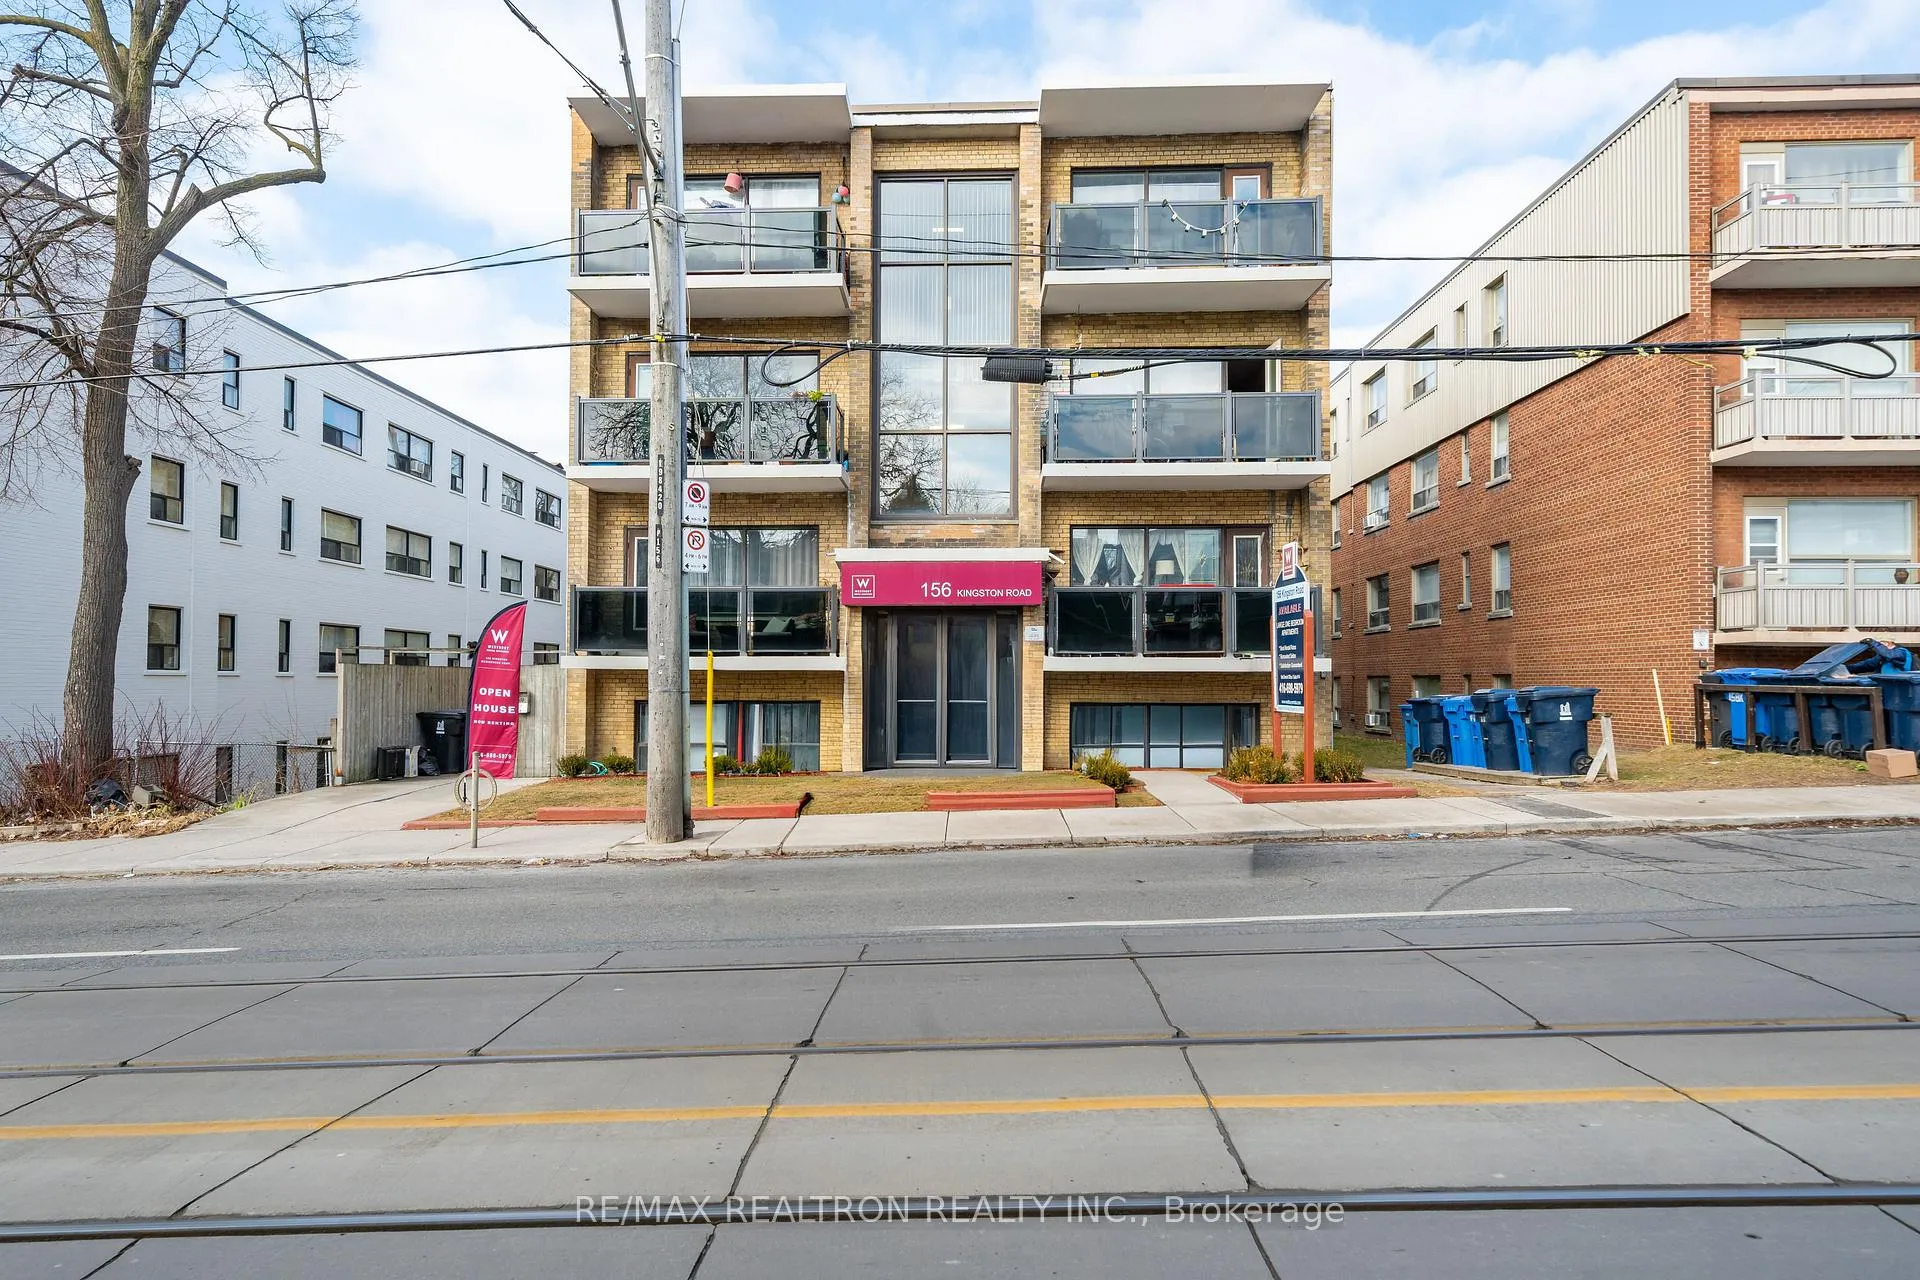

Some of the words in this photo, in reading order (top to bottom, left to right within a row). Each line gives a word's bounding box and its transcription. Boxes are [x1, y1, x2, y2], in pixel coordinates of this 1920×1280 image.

[856, 578, 869, 589] W
[921, 582, 952, 598] 156
[957, 588, 1004, 597] KINGSTON
[1006, 588, 1033, 597] ROAD
[491, 629, 509, 644] W
[479, 687, 511, 697] OPEN
[474, 703, 516, 714] HOUSE
